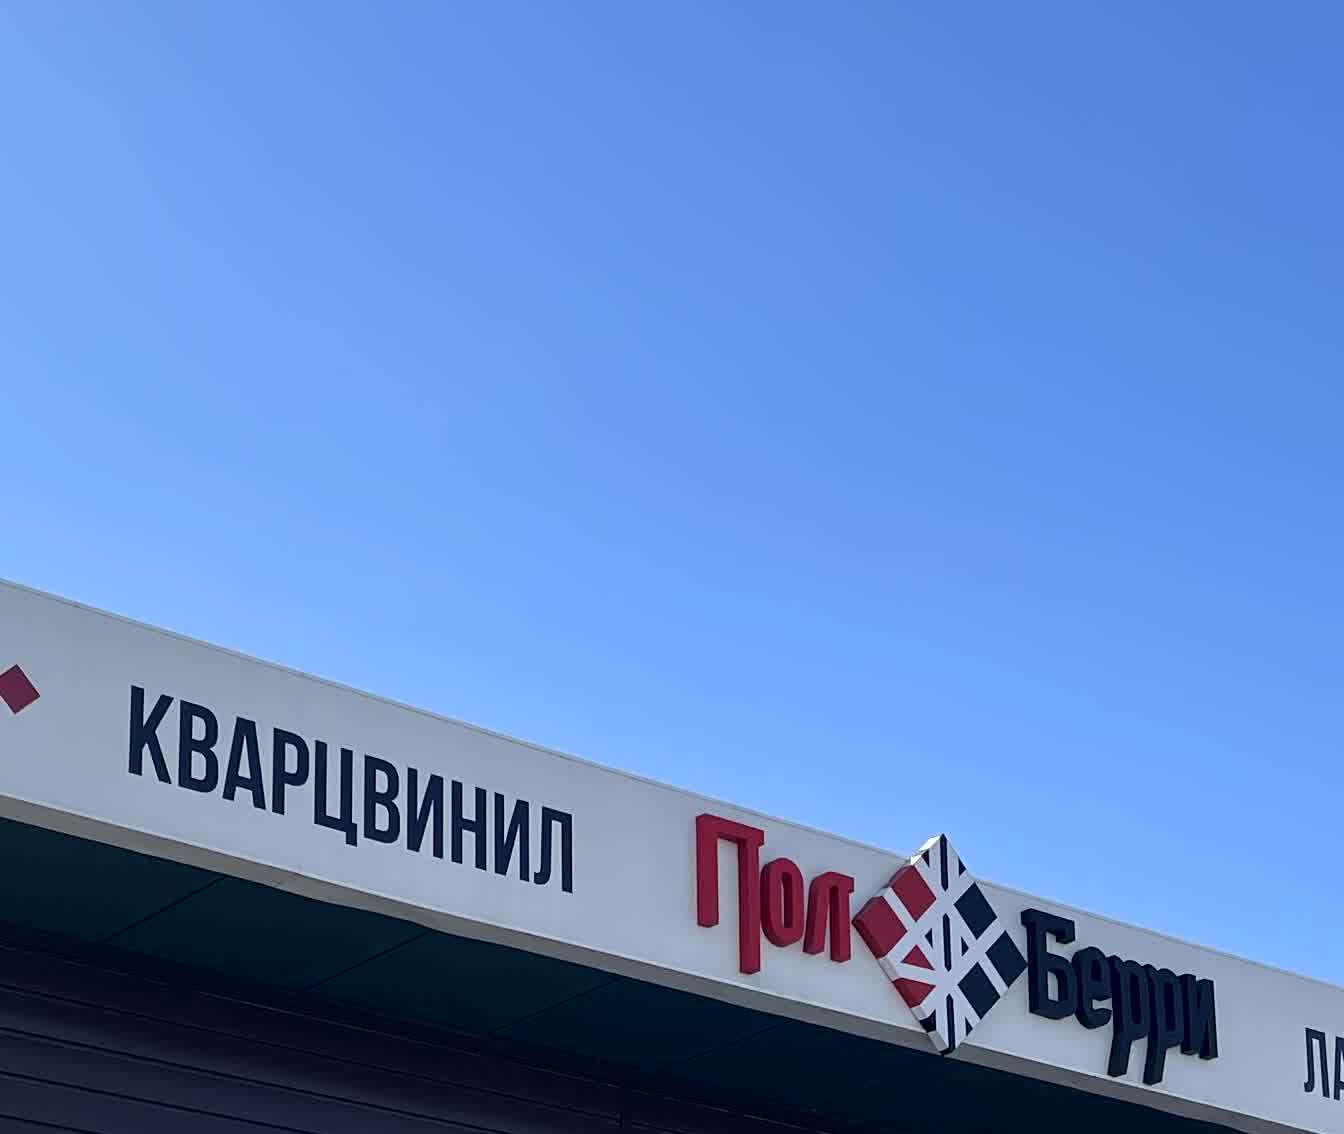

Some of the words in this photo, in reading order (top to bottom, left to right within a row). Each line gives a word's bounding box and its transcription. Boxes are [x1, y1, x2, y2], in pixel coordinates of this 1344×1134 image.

[128, 684, 573, 893] КВАРЦВИНИЛ
[695, 813, 854, 975] Пол
[1020, 908, 1219, 1086] Берри
